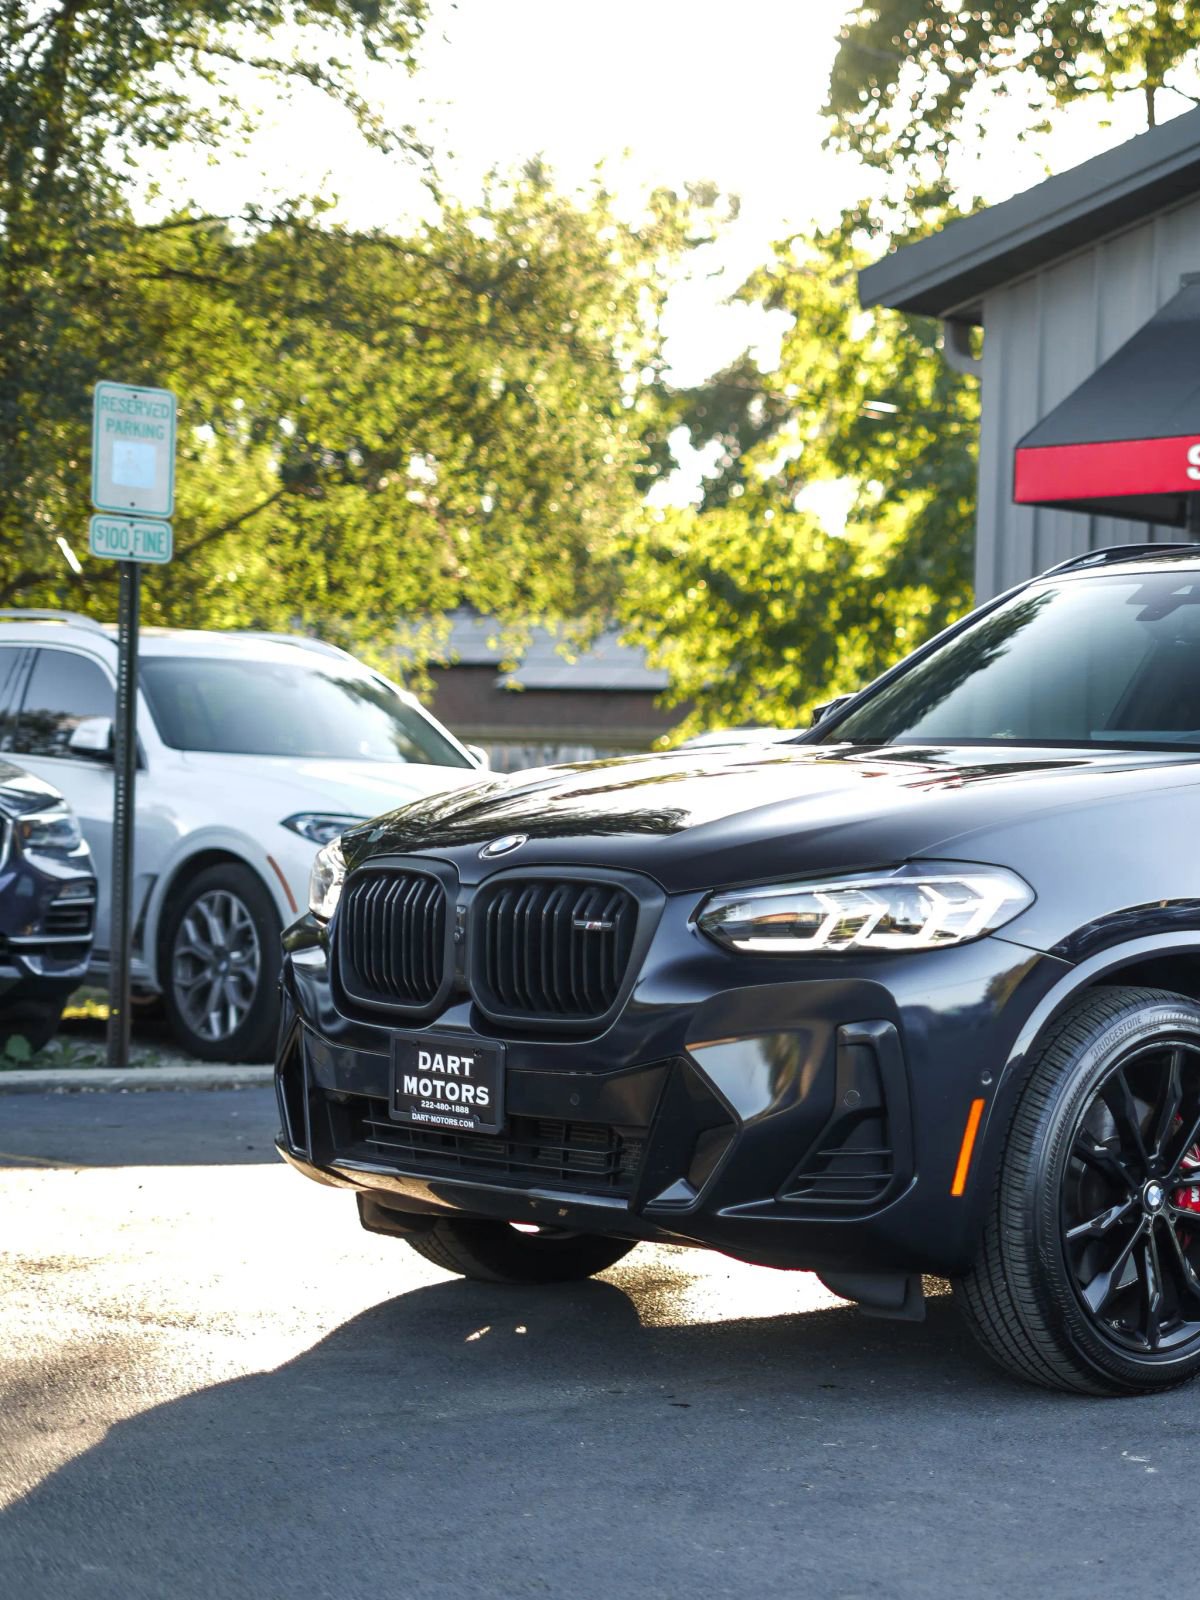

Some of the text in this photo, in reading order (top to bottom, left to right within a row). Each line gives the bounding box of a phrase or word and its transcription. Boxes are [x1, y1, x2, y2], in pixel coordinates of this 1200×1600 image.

[100, 395, 169, 419] RESERVED
[105, 418, 165, 441] PARKING
[95, 524, 165, 554] $100 FINE
[418, 1051, 474, 1076] DART
[403, 1075, 490, 1105] MOTORS
